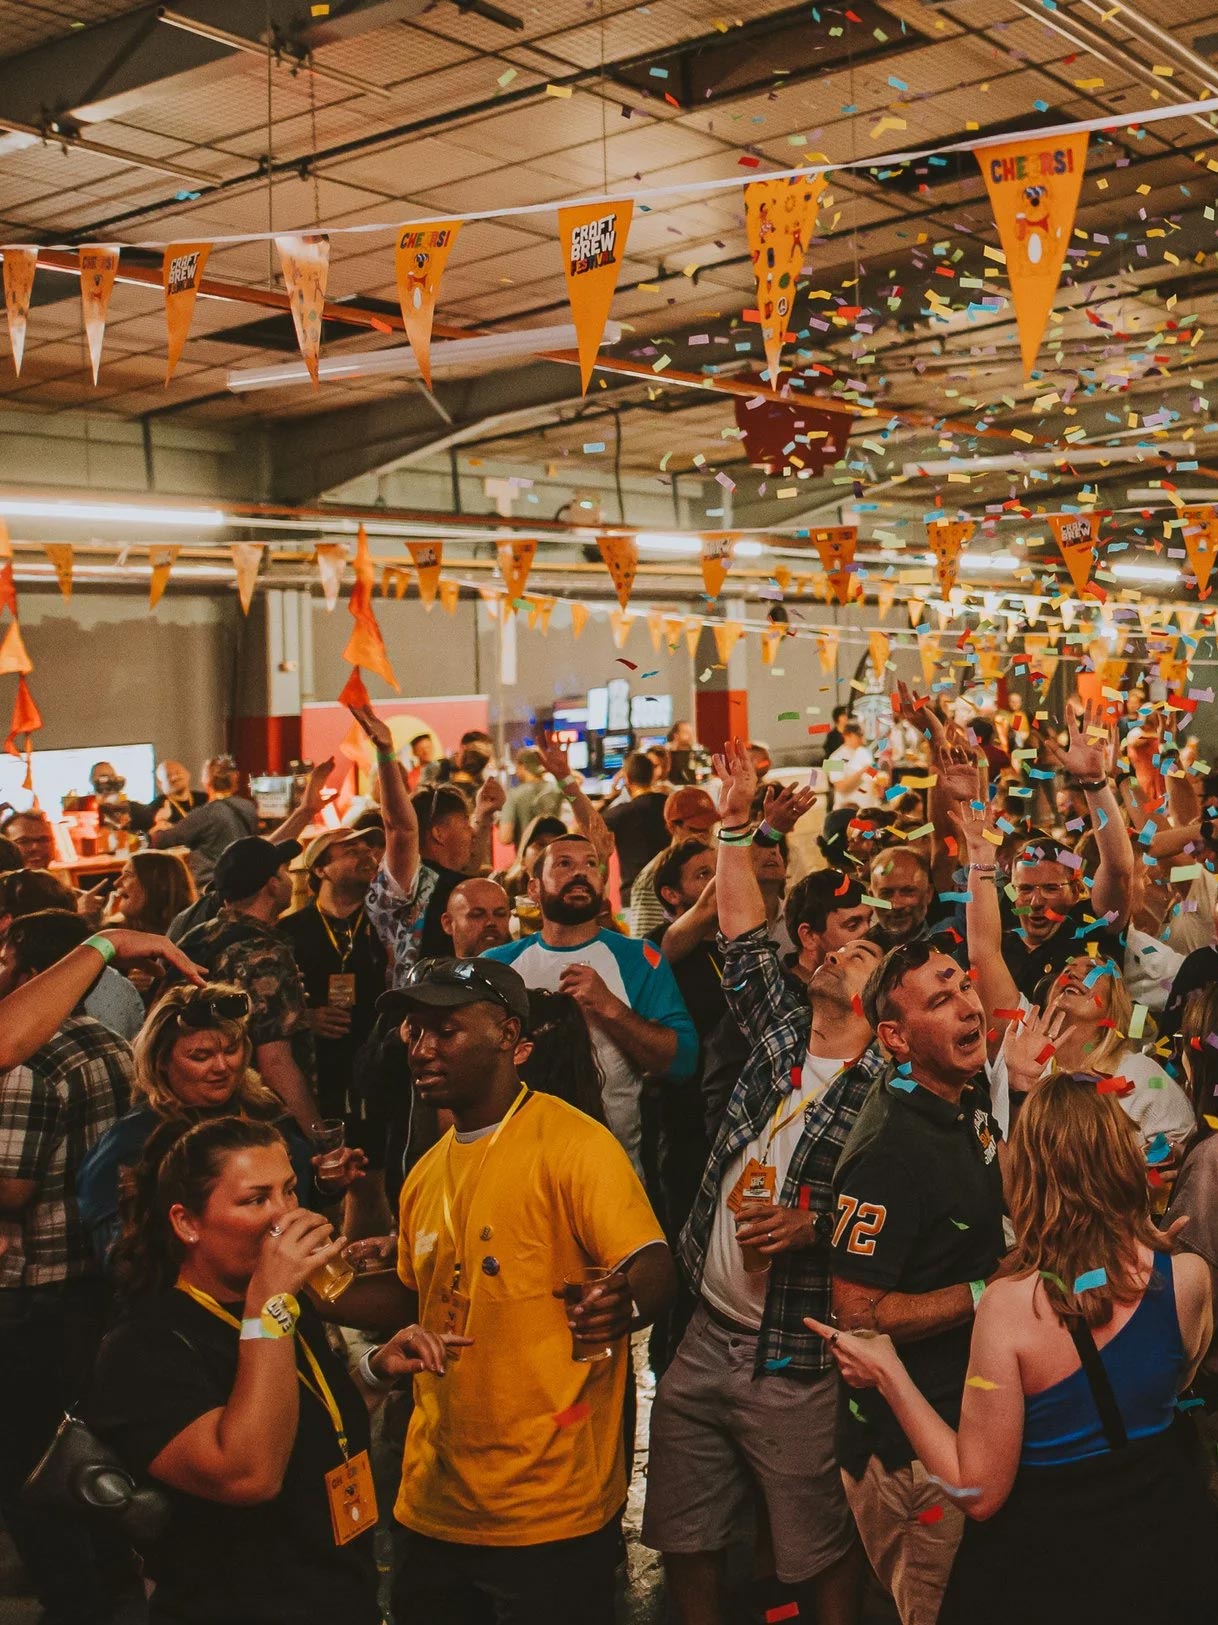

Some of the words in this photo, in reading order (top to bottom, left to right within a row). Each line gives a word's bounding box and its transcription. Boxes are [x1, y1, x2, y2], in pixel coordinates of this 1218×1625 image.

[991, 148, 1075, 184] CHERS!
[400, 230, 451, 249] CHERS!
[570, 230, 616, 262] BREW
[571, 213, 617, 246] CRAFT
[831, 1193, 887, 1256] 72
